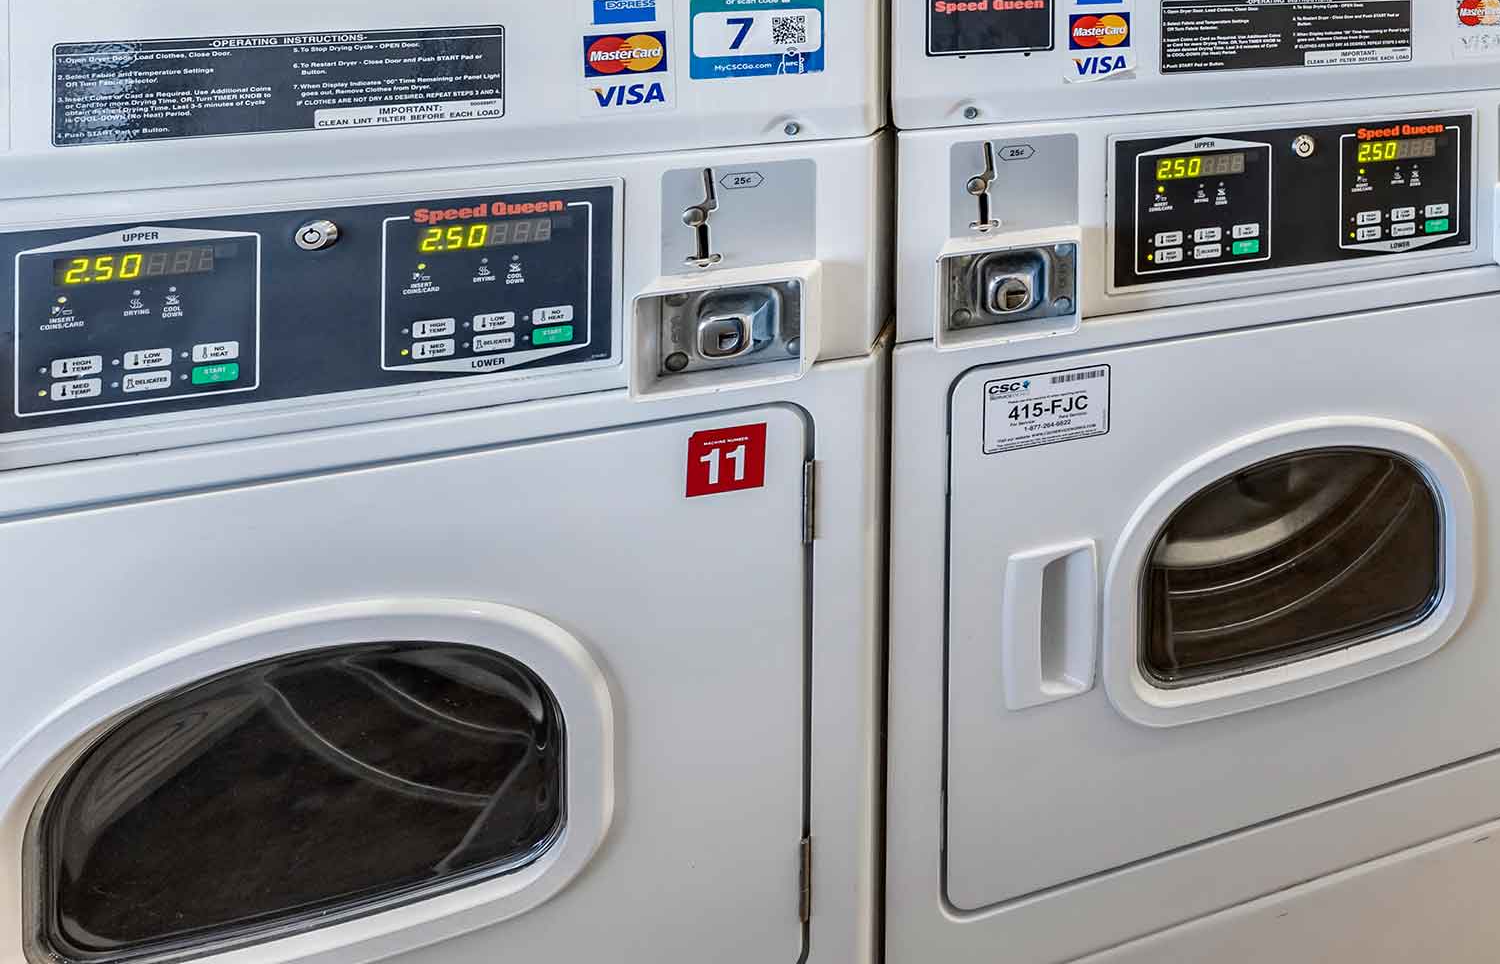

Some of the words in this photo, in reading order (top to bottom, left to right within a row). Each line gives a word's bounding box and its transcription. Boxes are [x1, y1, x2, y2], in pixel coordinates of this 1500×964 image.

[604, 0, 656, 11] EXPRESS
[934, 0, 988, 14] Speed
[726, 17, 754, 50] 7
[1072, 25, 1127, 37] MasterCard
[590, 47, 661, 62] MasterCard
[714, 62, 772, 73] MyCSCGo.com
[1073, 55, 1127, 76] VISA
[594, 83, 665, 108] VISA
[379, 104, 443, 115] IMPORTANT:
[318, 118, 349, 127] CLEAN
[353, 117, 372, 125] LINT
[376, 115, 406, 123] FILTER
[410, 113, 445, 121] BEFORE
[449, 110, 473, 118] EACH
[476, 109, 500, 117] LOAD
[1357, 126, 1400, 140] Speed
[1402, 124, 1444, 136] Queen
[1194, 141, 1215, 149] UPPER
[1357, 142, 1397, 162] 2.50
[1157, 157, 1201, 180] 2.50
[413, 203, 489, 224] Speed
[491, 200, 564, 217] Queen
[122, 231, 159, 243] UPPER
[421, 224, 488, 251] 2.50
[1390, 241, 1411, 249] LOWER
[64, 252, 143, 284] 2.50
[123, 308, 151, 317] DRYING
[49, 316, 76, 324] INSERT
[142, 357, 163, 365] TEMP
[143, 352, 161, 360] LOW
[71, 364, 93, 373] TEMP
[72, 359, 92, 367] HIGH
[471, 357, 505, 369] LOWER
[72, 382, 90, 390] MED
[134, 376, 168, 385] DELICATES
[70, 387, 92, 396] TEMP
[988, 382, 1021, 395] CSC
[1008, 395, 1089, 421] 415-FJC
[700, 444, 746, 485] 11
